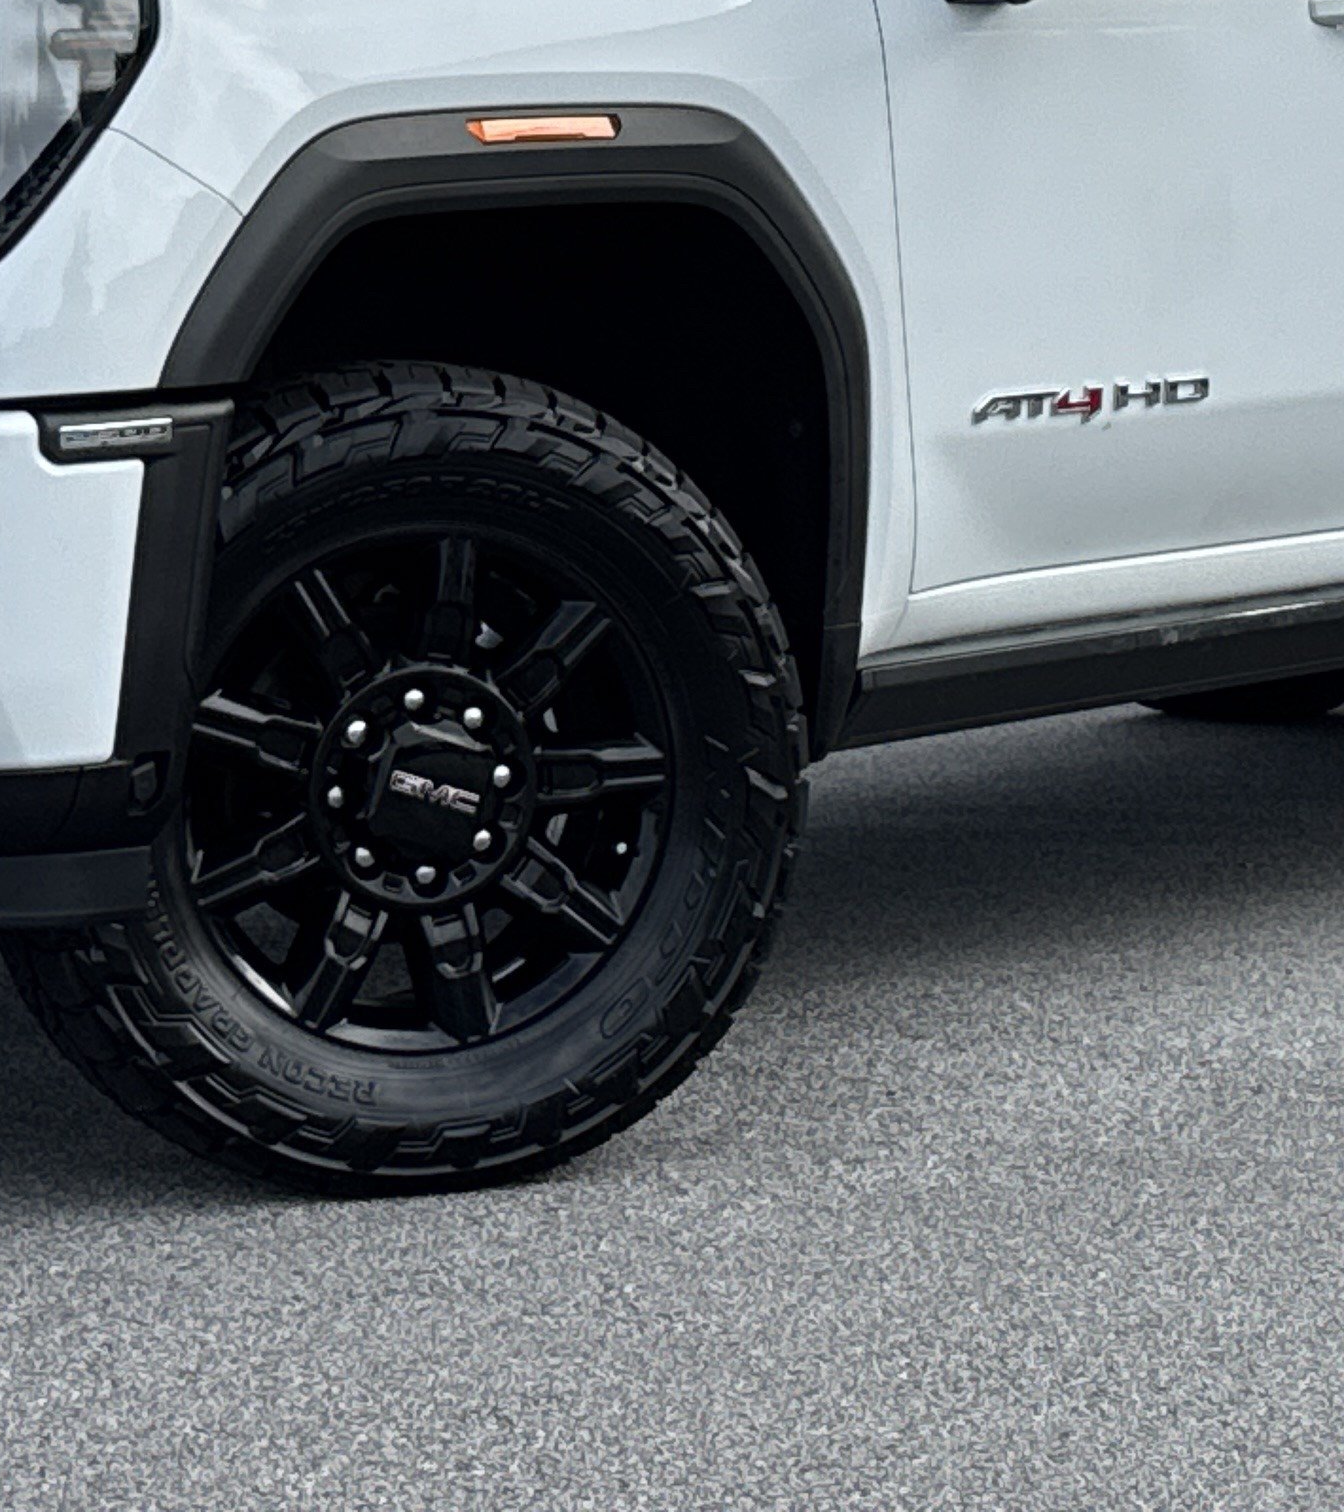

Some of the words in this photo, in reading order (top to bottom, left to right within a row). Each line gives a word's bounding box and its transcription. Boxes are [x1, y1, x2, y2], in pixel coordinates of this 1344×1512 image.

[971, 384, 1105, 425] AT4
[1112, 371, 1211, 413] HD
[390, 770, 481, 814] GMC
[257, 1044, 380, 1107] RECON
